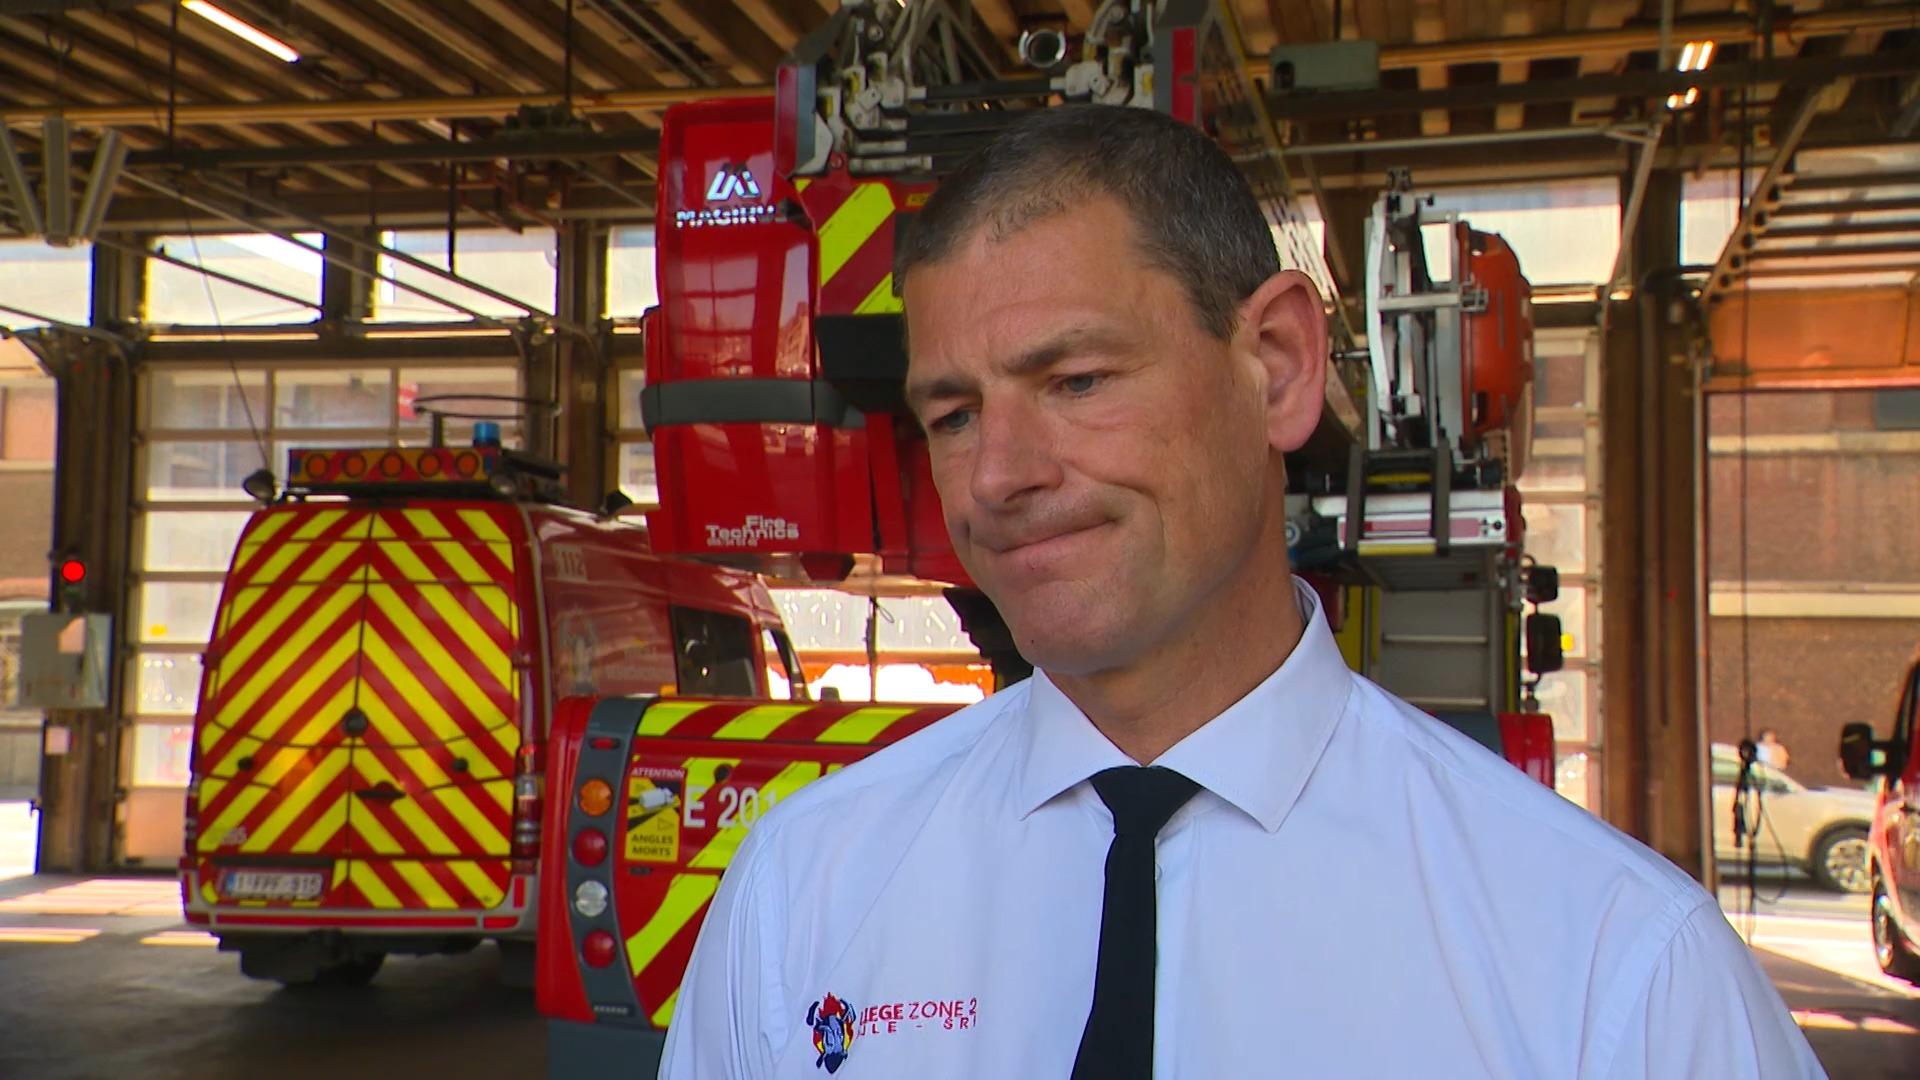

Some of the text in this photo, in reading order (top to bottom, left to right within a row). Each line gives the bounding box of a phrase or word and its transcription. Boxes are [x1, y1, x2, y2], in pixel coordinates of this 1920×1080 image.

[745, 515, 786, 530] Fire
[705, 524, 799, 540] Technics
[631, 767, 685, 779] ATTENTION
[683, 784, 706, 828] E
[632, 832, 674, 845] ANGLES
[632, 845, 672, 856] MORTS
[908, 1000, 964, 1020] ZONE
